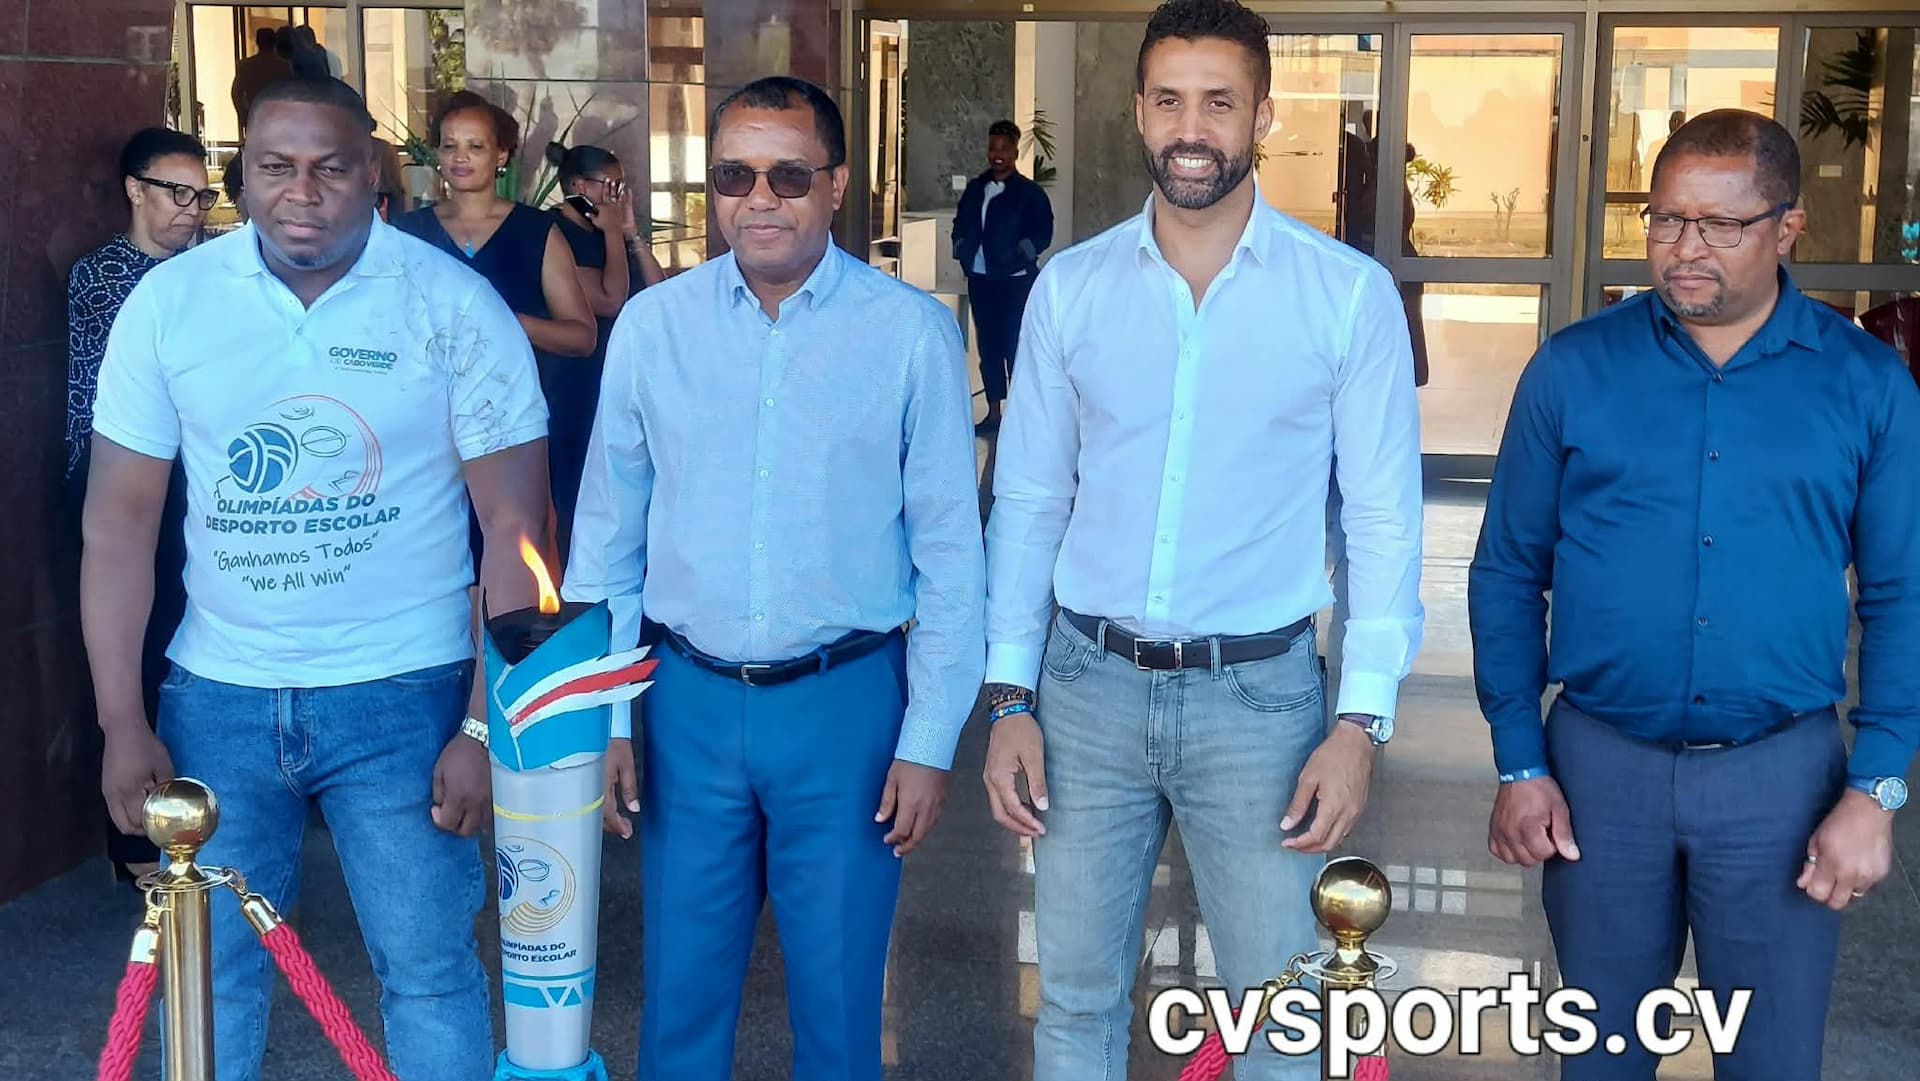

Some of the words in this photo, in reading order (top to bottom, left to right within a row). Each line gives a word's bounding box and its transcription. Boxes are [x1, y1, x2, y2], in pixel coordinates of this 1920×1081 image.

[328, 346, 398, 363] GOVERNO
[217, 496, 339, 514] OLIMPÍADAS
[345, 493, 376, 510] DO
[206, 514, 297, 534] DESPORTO
[303, 506, 400, 534] ESCOLAR
[282, 571, 305, 592] All
[531, 949, 577, 962] ESCOLAR
[550, 942, 566, 951] DO
